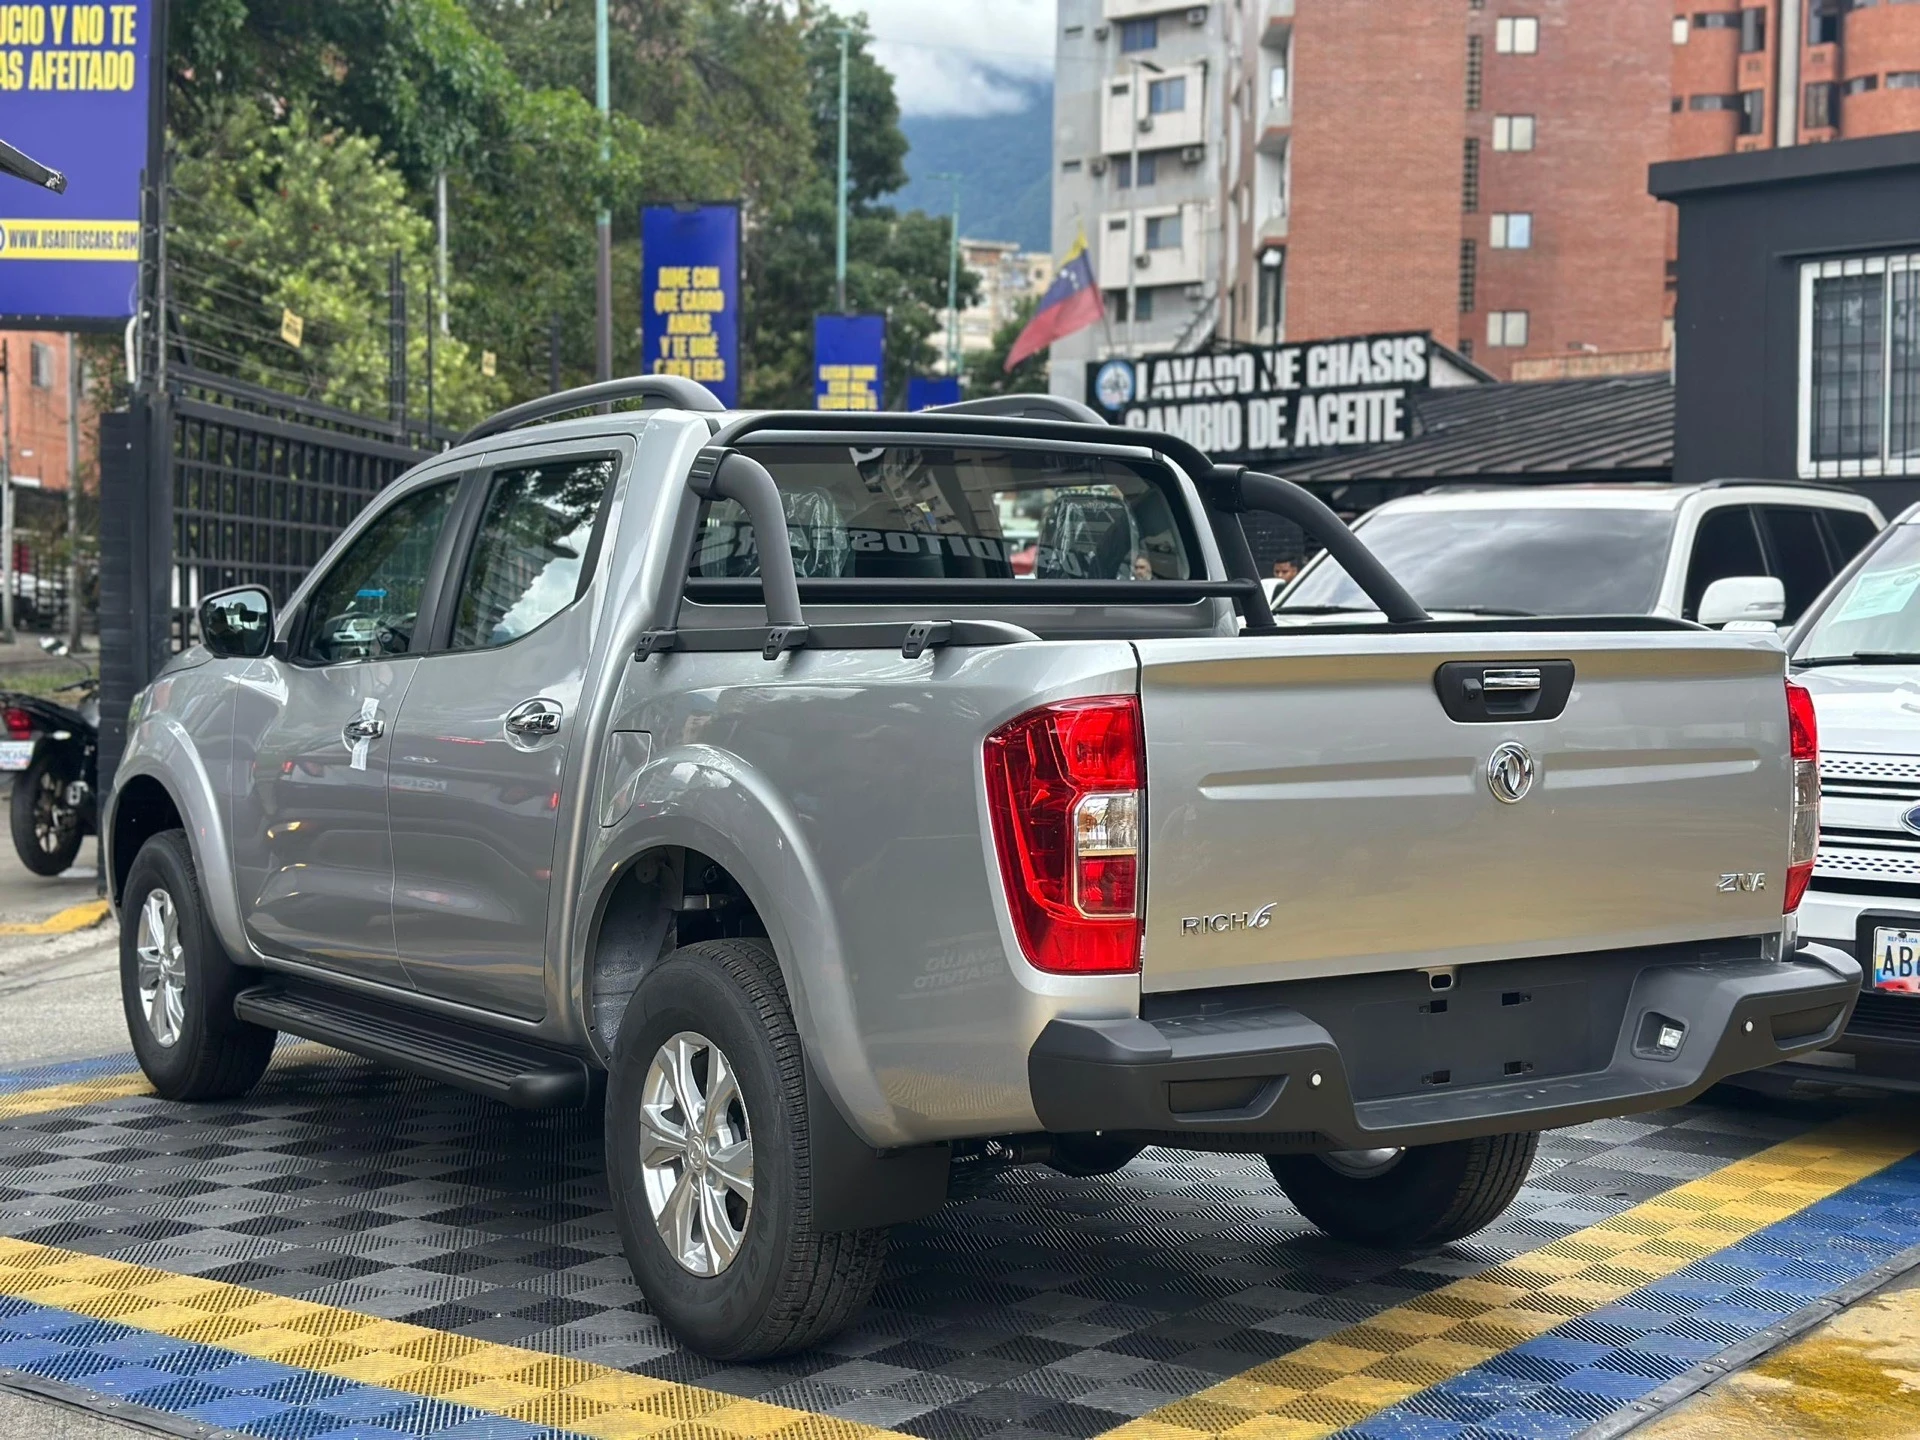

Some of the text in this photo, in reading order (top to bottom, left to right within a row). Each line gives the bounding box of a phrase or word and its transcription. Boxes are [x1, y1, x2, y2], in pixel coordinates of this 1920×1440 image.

[50, 5, 67, 45] Y
[72, 4, 104, 45] NO
[109, 4, 137, 45] TE
[28, 50, 135, 91] AFEITADO
[8, 229, 138, 249] WWW.USADITOSCARS.COM
[1306, 336, 1427, 389] CHASIS
[1248, 397, 1289, 450] DE
[1294, 389, 1405, 448] ACEITE
[1882, 945, 1920, 977] AB
